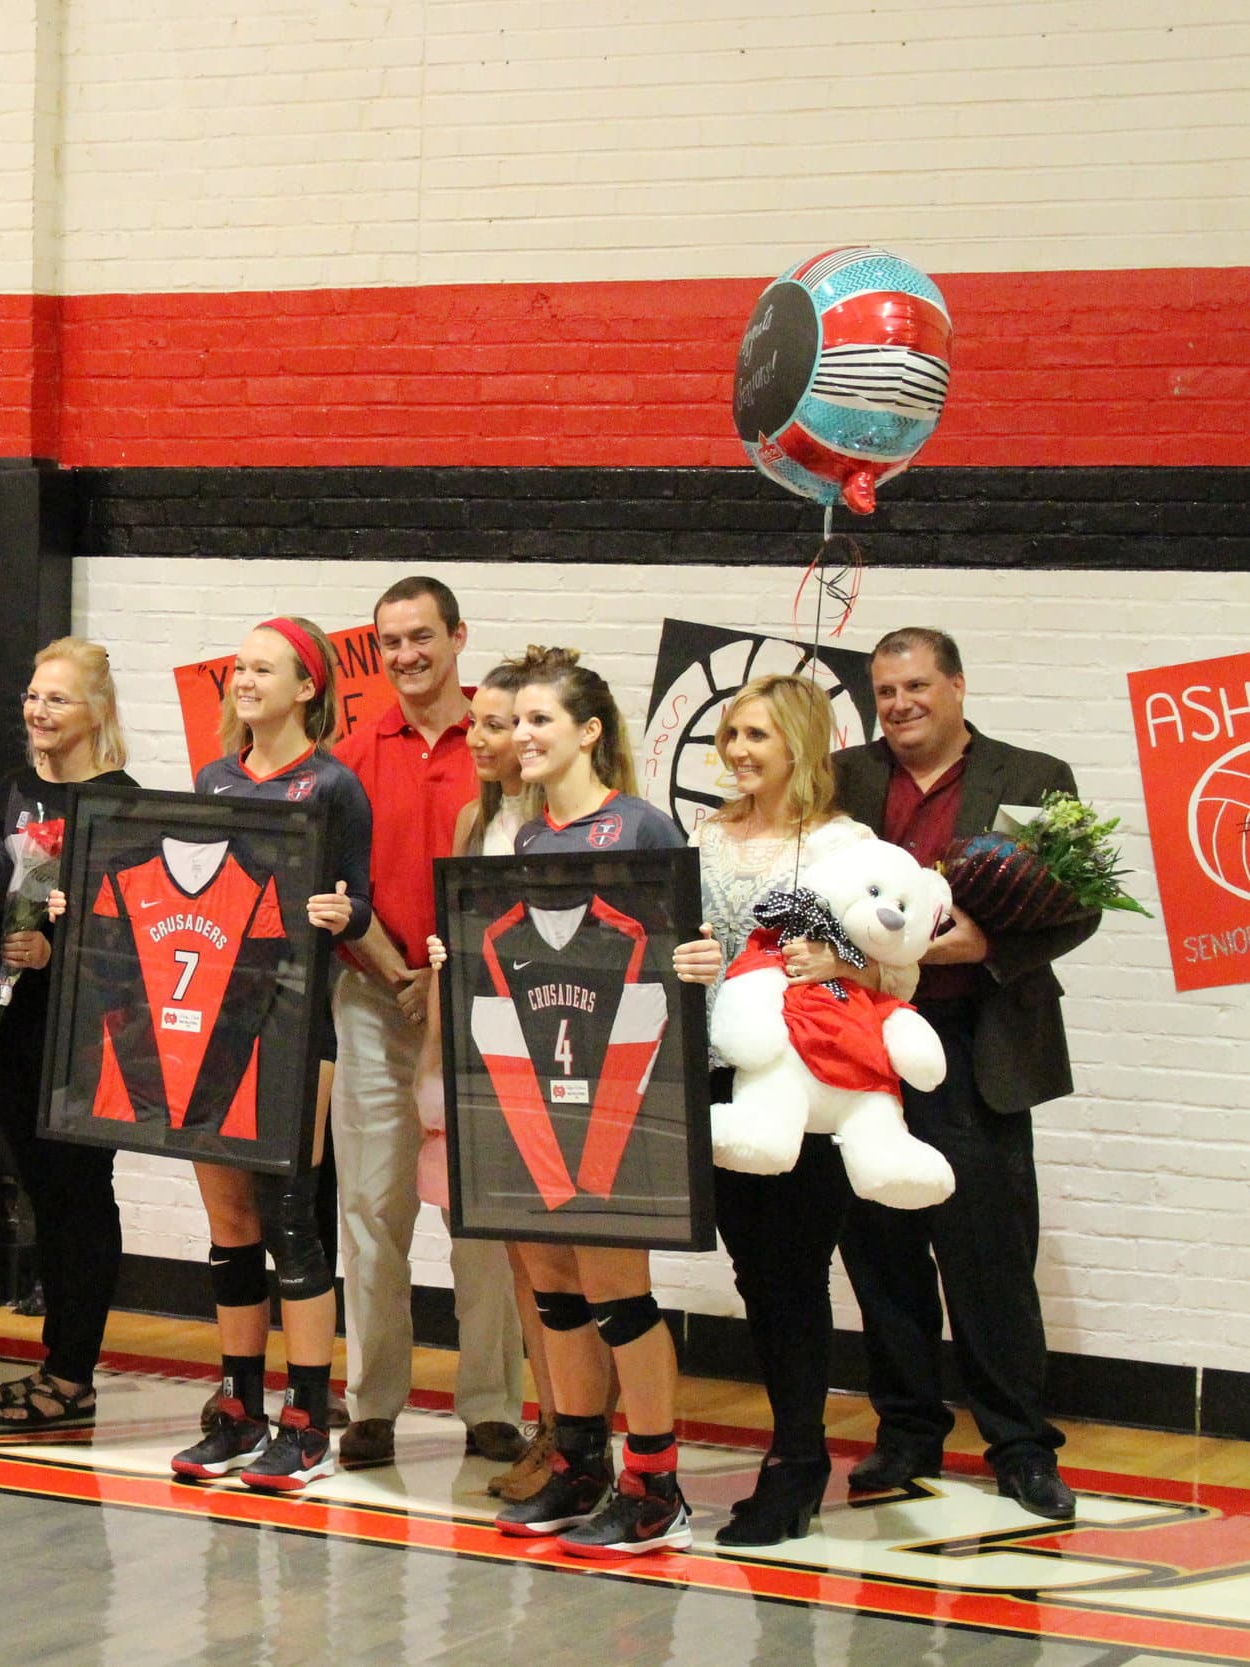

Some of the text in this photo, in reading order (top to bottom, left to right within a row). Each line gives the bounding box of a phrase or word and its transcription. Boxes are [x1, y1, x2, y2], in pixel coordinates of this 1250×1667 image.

[149, 913, 228, 951] CRUSADERS
[172, 949, 200, 1001] 7
[527, 983, 597, 1013] CRUSADERS
[554, 1019, 573, 1075] 4
